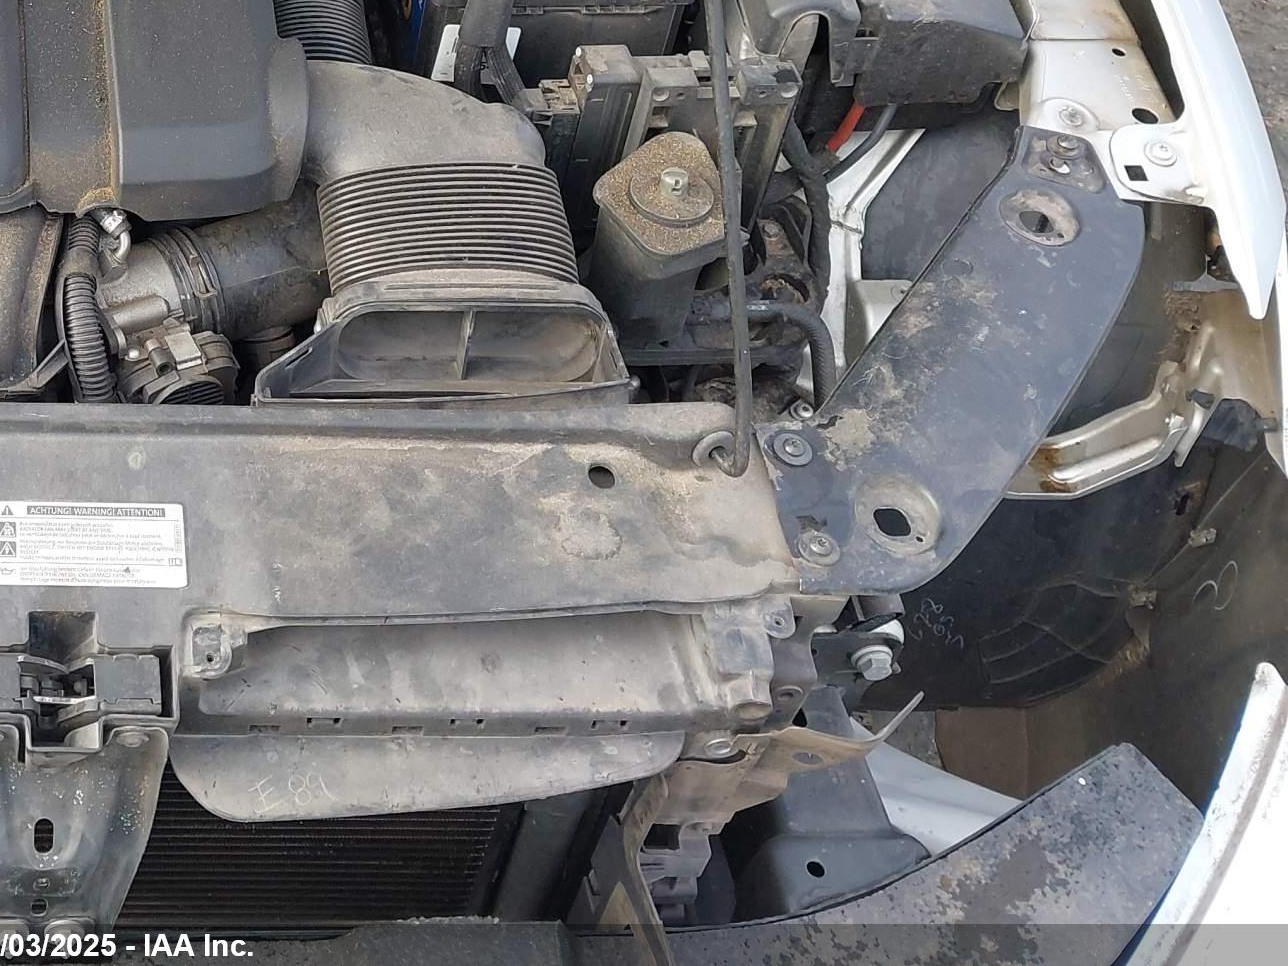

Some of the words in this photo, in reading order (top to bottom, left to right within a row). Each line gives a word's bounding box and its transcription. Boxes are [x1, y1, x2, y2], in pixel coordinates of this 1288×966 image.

[29, 506, 73, 516] ACHTUNG!
[73, 507, 114, 516] WARNING!
[116, 508, 164, 517] ATTENTION!
